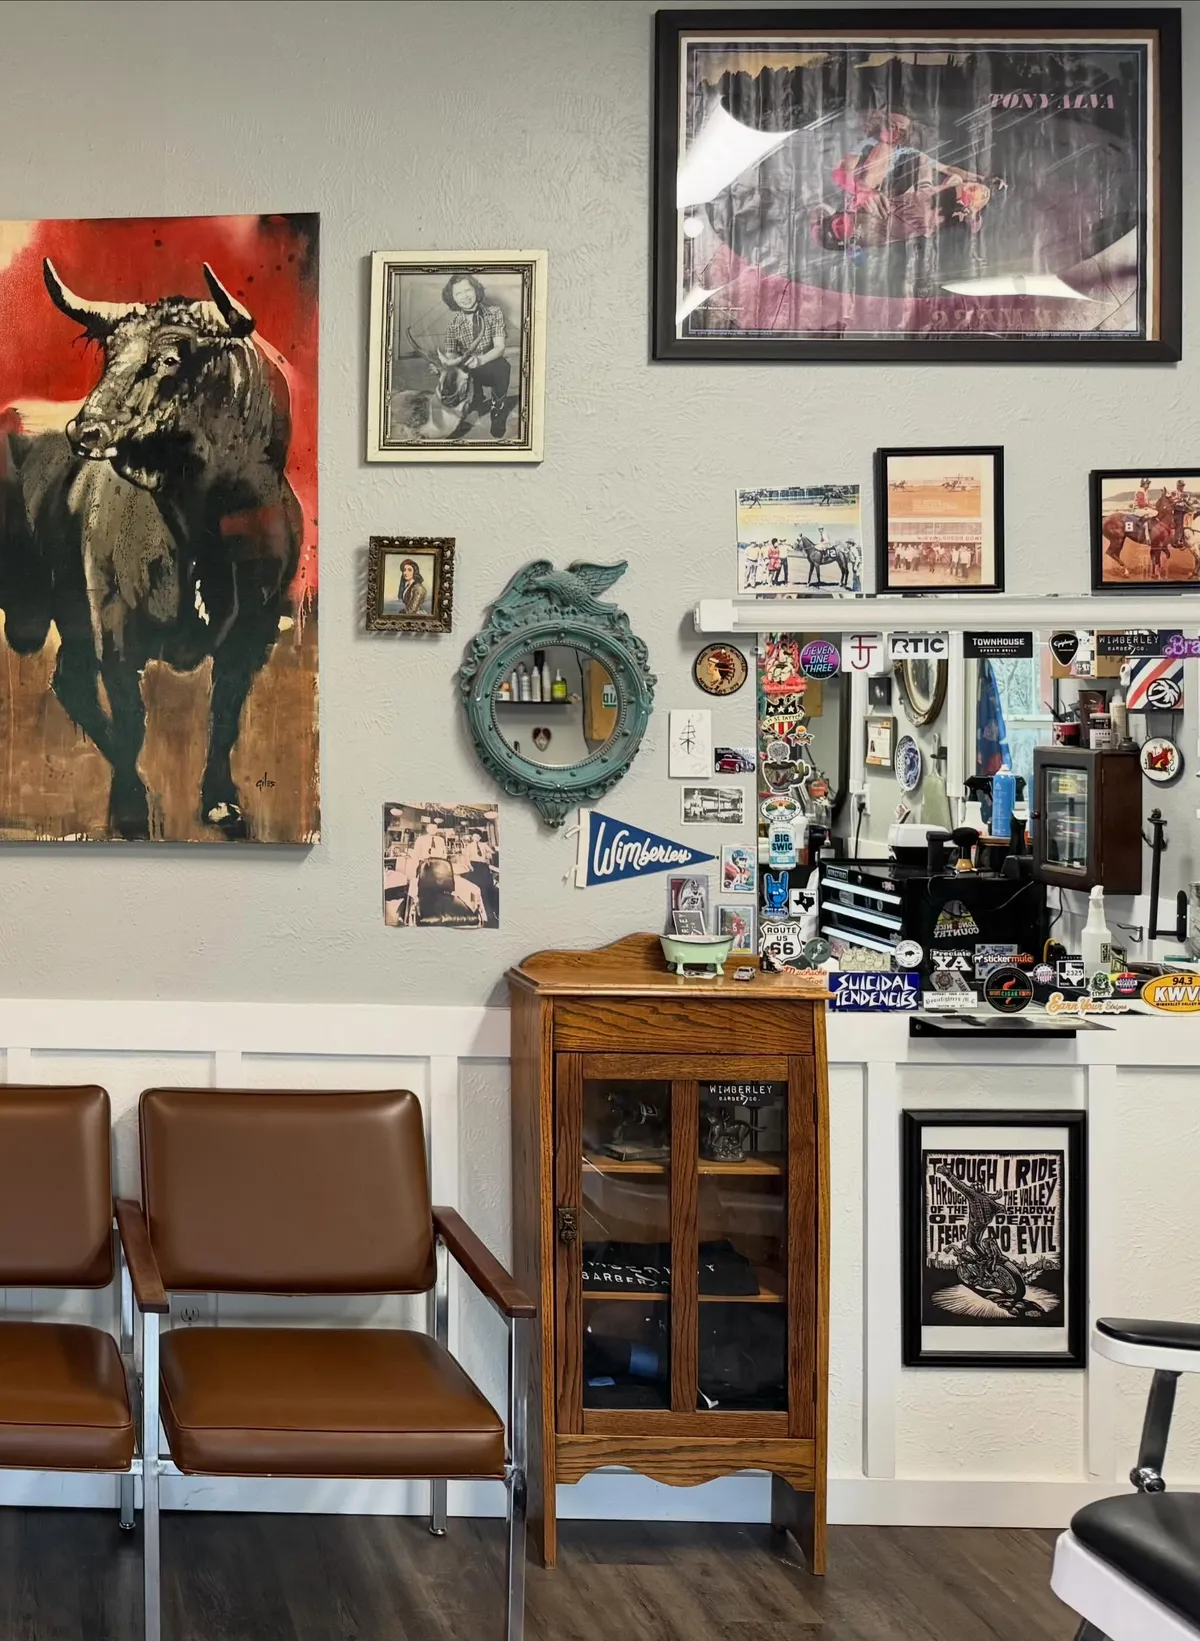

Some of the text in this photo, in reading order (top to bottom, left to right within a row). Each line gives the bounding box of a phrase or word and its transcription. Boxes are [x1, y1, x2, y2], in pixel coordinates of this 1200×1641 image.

[989, 93, 1115, 110] TONY ALVA
[972, 637, 1025, 646] TOWNHOUSE
[1098, 635, 1159, 644] WIMBERLEY
[892, 638, 944, 653] RTIC
[803, 646, 835, 656] SEVEN
[810, 655, 829, 664] ONE
[804, 664, 833, 673] THREE
[774, 834, 789, 842] BIG
[593, 821, 692, 876] Wimberley
[772, 843, 793, 851] SWIG
[770, 942, 794, 955] 66
[932, 949, 972, 957] Preciate
[932, 956, 972, 971] YA
[983, 954, 1034, 963] stickermule
[836, 973, 916, 991] SUICIDAL
[1172, 976, 1193, 986] 94.3
[1154, 986, 1200, 1002] KWV
[834, 990, 917, 1010] TENDENCIES
[1047, 993, 1078, 1013] Earn
[1079, 996, 1103, 1014] Your
[709, 1085, 773, 1094] WIMBERLEY
[929, 1157, 1057, 1192] THOUGH I RIDE
[928, 1174, 1058, 1206] THROUGH THE VALLEY
[930, 1206, 1056, 1214] OF THE SHADOW
[929, 1215, 1055, 1225] OF DEATH
[929, 1225, 1056, 1254] I FEAR NO EVIL
